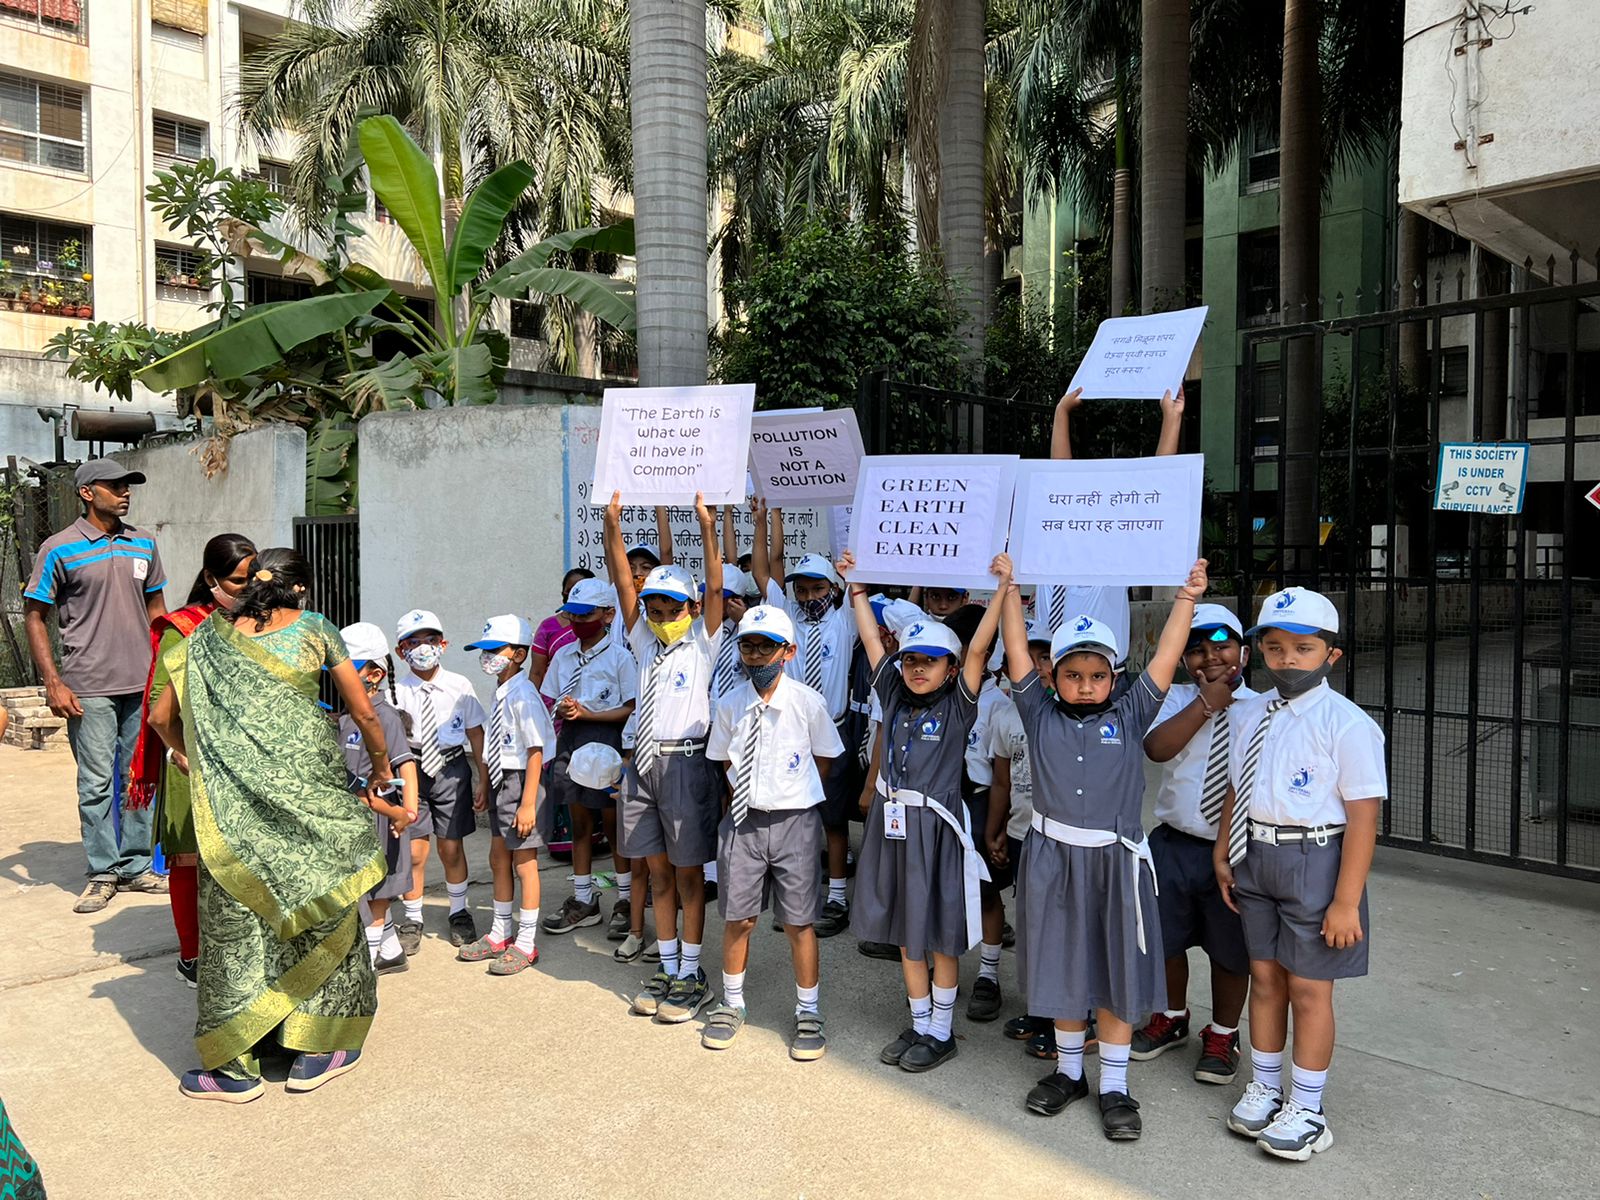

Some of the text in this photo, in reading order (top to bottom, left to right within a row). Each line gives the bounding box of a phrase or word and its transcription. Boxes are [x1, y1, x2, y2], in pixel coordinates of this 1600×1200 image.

[661, 407, 704, 420] Earth
[709, 406, 721, 418] is
[637, 426, 701, 439] what we
[752, 427, 838, 443] POLLUTION
[629, 444, 704, 458] all have in
[788, 446, 804, 457] IS
[1449, 449, 1518, 460] THIS SOCIETY
[780, 459, 826, 472] NOT A
[1458, 467, 1505, 478] IS UNDER
[770, 472, 846, 487] SOLUTION
[881, 478, 970, 492] GREEN
[1465, 485, 1492, 496] CCTV
[1048, 489, 1162, 507] धरा नहीं होगी तो
[879, 499, 967, 514] EARTH
[788, 512, 796, 525] न
[878, 520, 960, 535] CLEAN
[1041, 519, 1164, 533] सब धरा रह जाएगा
[800, 529, 807, 550] है
[874, 541, 960, 557] EARTH
